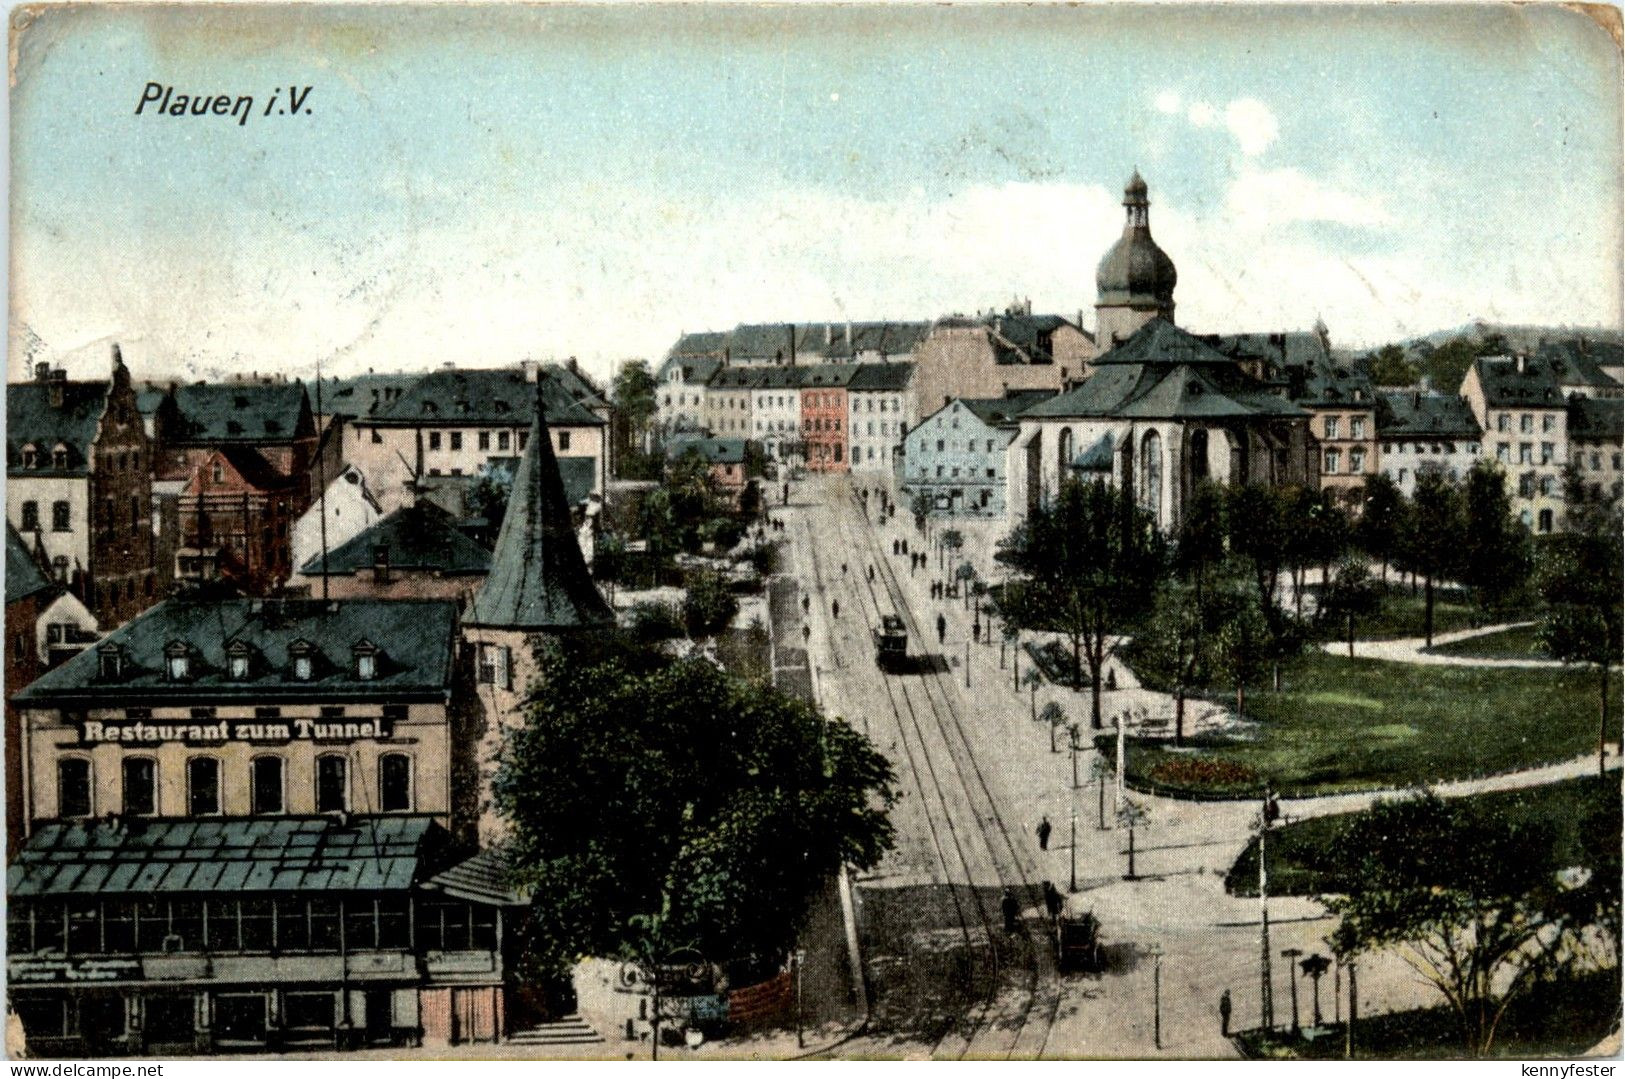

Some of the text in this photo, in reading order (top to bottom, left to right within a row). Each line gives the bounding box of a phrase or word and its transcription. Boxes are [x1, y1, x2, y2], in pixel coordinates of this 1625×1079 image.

[84, 718, 389, 742] Restaurant zum Tunnel.
